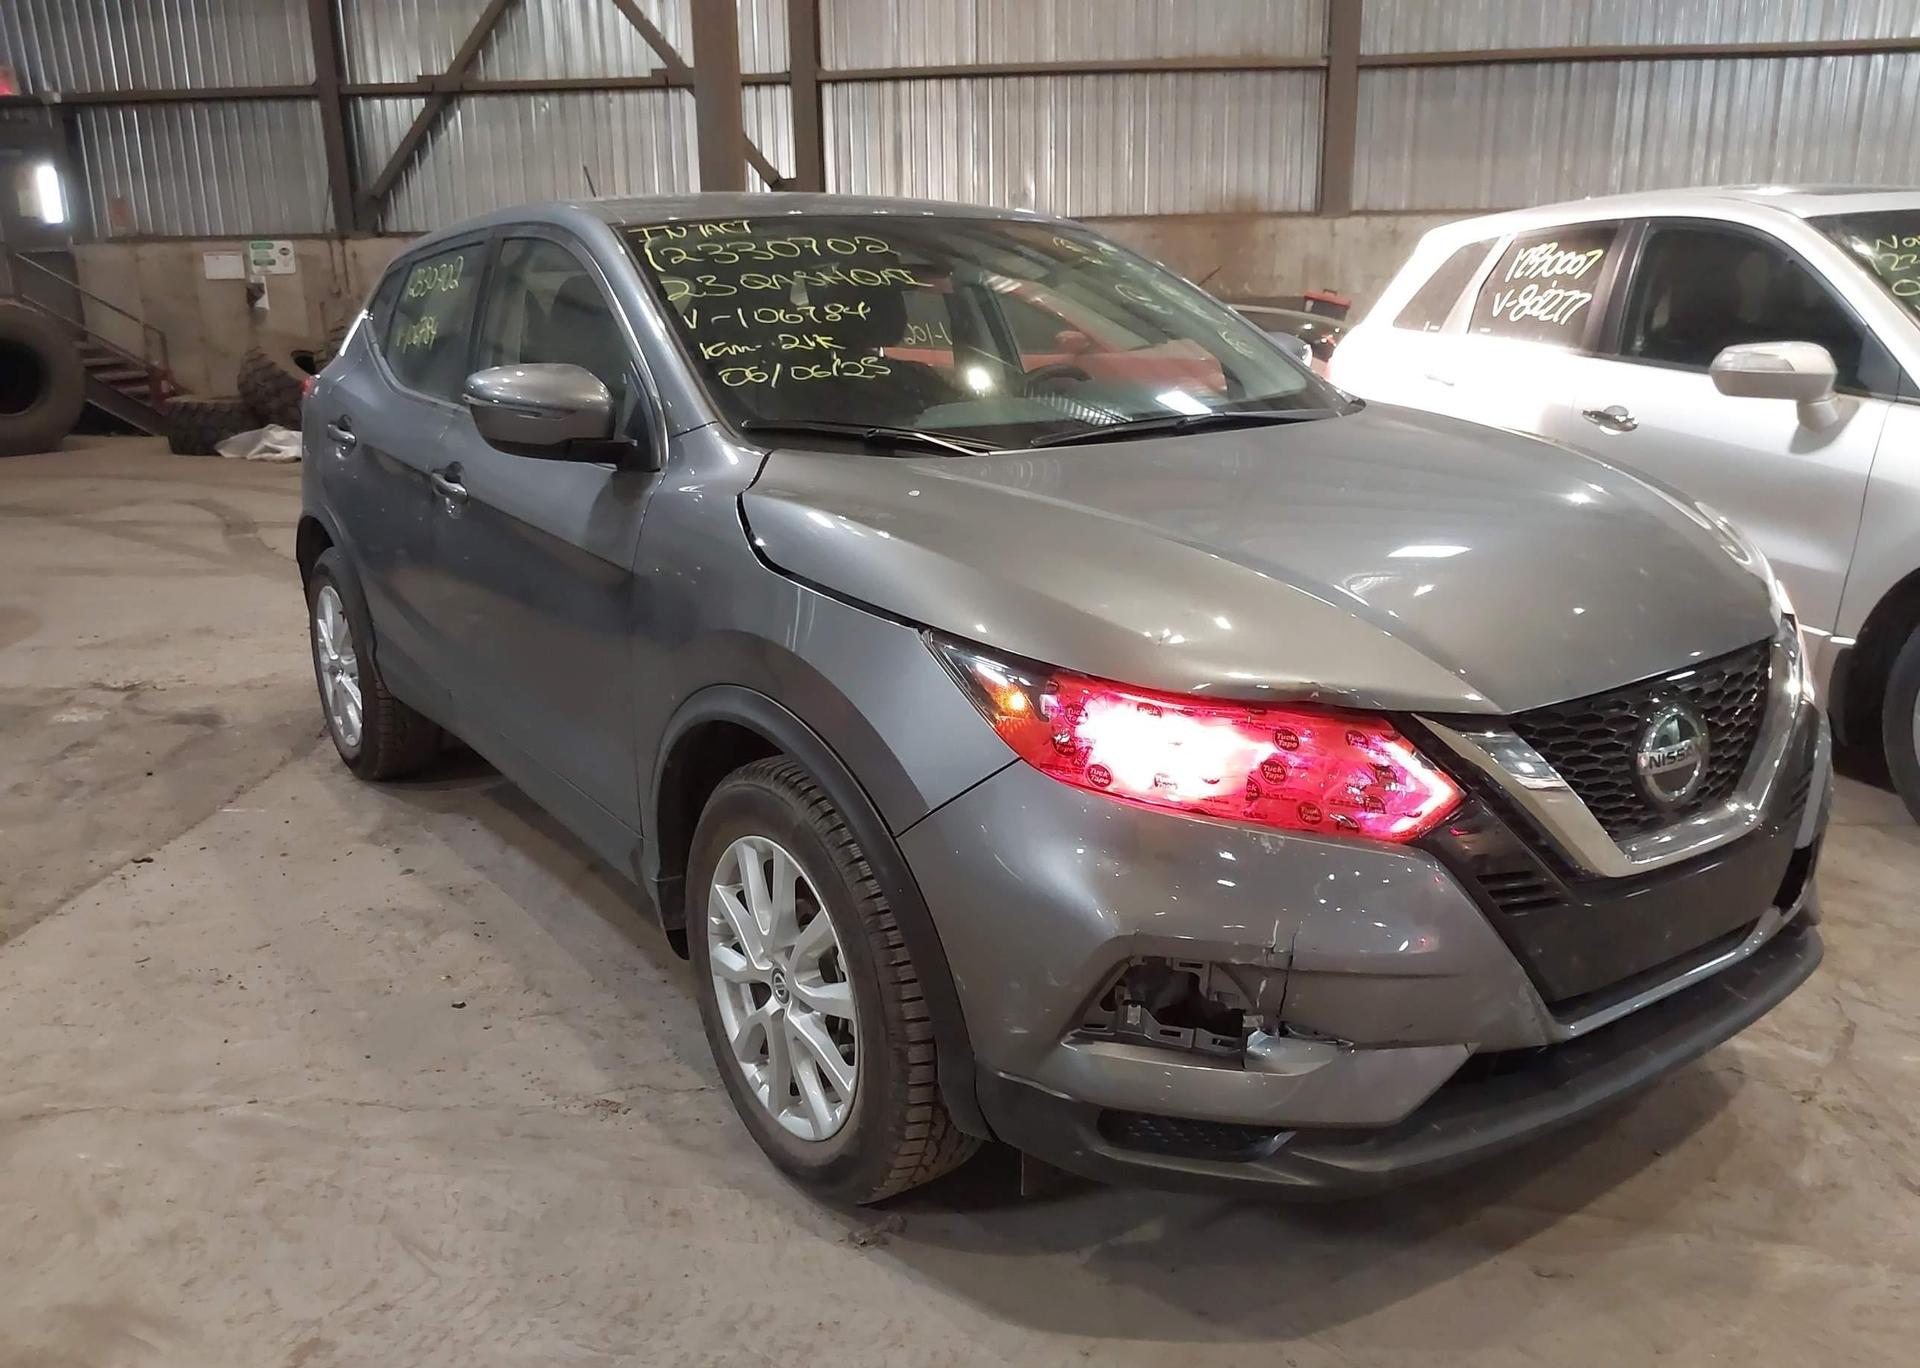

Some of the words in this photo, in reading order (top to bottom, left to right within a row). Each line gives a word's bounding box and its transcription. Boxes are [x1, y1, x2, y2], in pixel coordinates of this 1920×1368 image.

[660, 275, 737, 300] 23
[1276, 732, 1297, 742] Tuck
[1278, 740, 1299, 749] Tape
[1089, 768, 1109, 778] Tuck
[1263, 764, 1284, 774] Tuck
[1091, 774, 1110, 785] Tape
[1265, 771, 1286, 781] Tape
